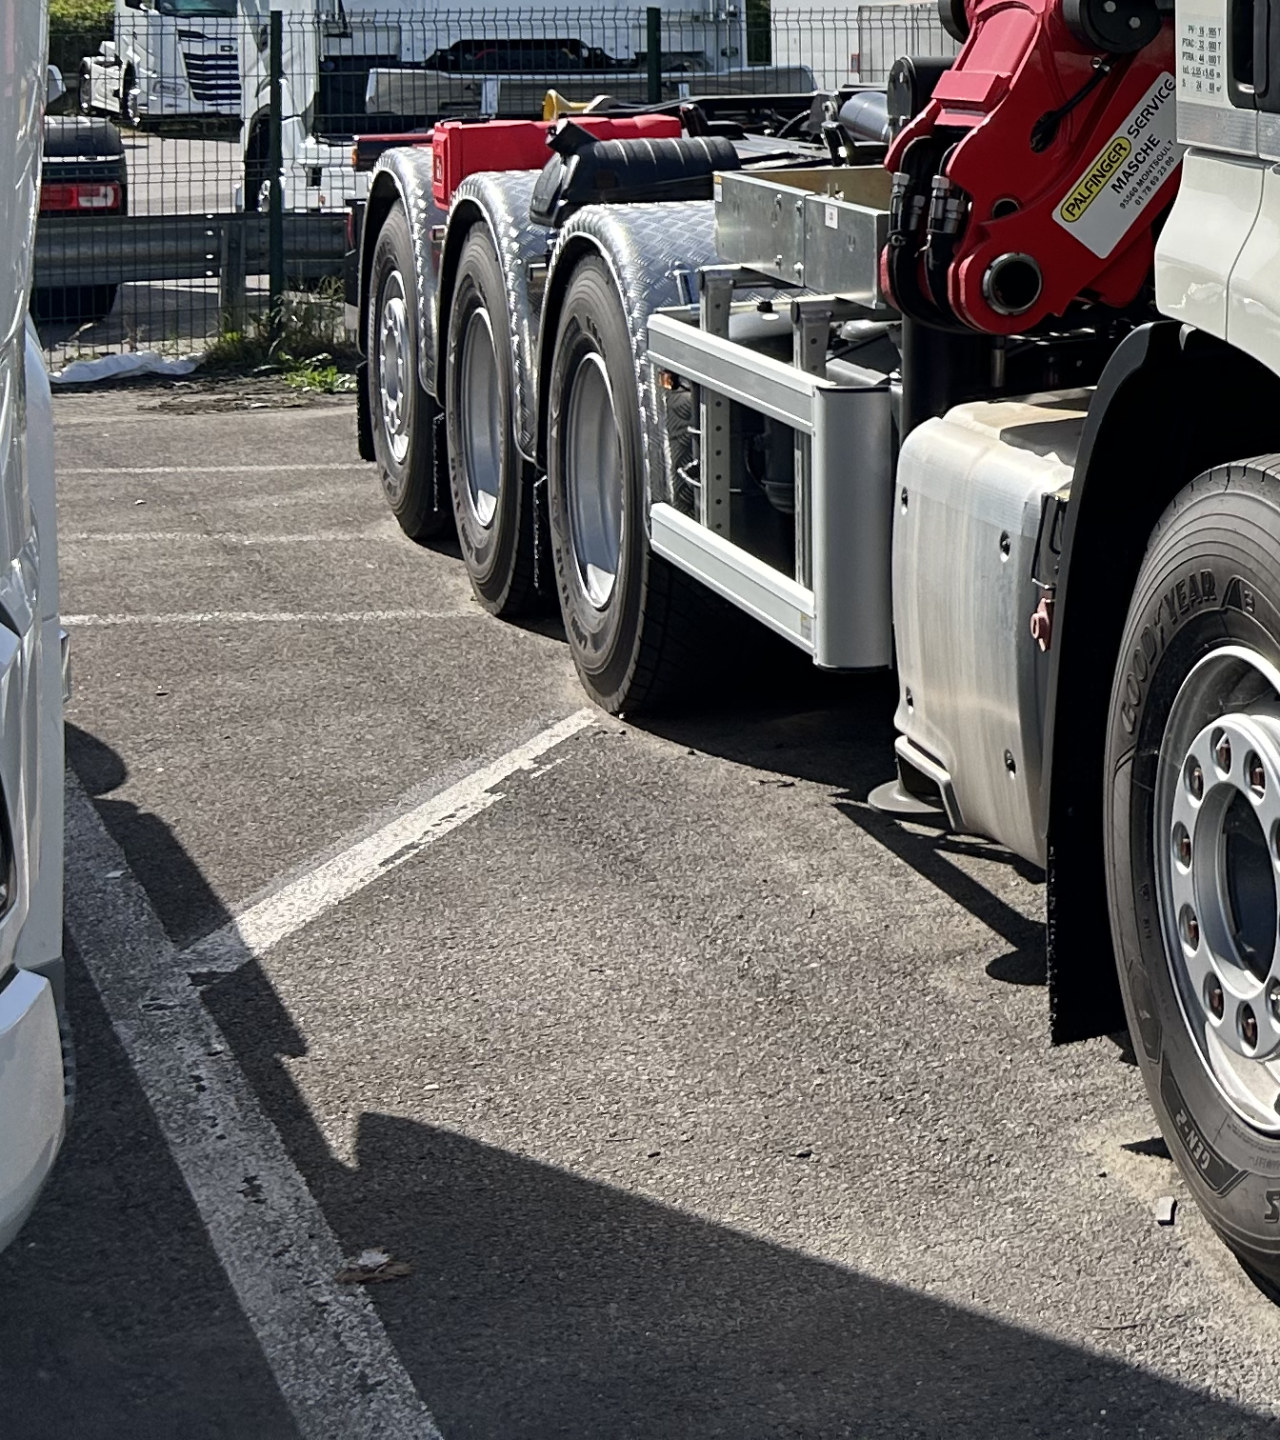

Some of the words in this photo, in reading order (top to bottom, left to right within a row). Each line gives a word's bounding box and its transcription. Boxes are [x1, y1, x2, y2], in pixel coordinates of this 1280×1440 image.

[1065, 142, 1127, 217] PALFINGER
[1127, 78, 1176, 139] SERVICE
[1111, 133, 1161, 193] MASCHE
[1121, 568, 1217, 733] GOODYEAR
[1175, 1109, 1210, 1170] GEN-2
